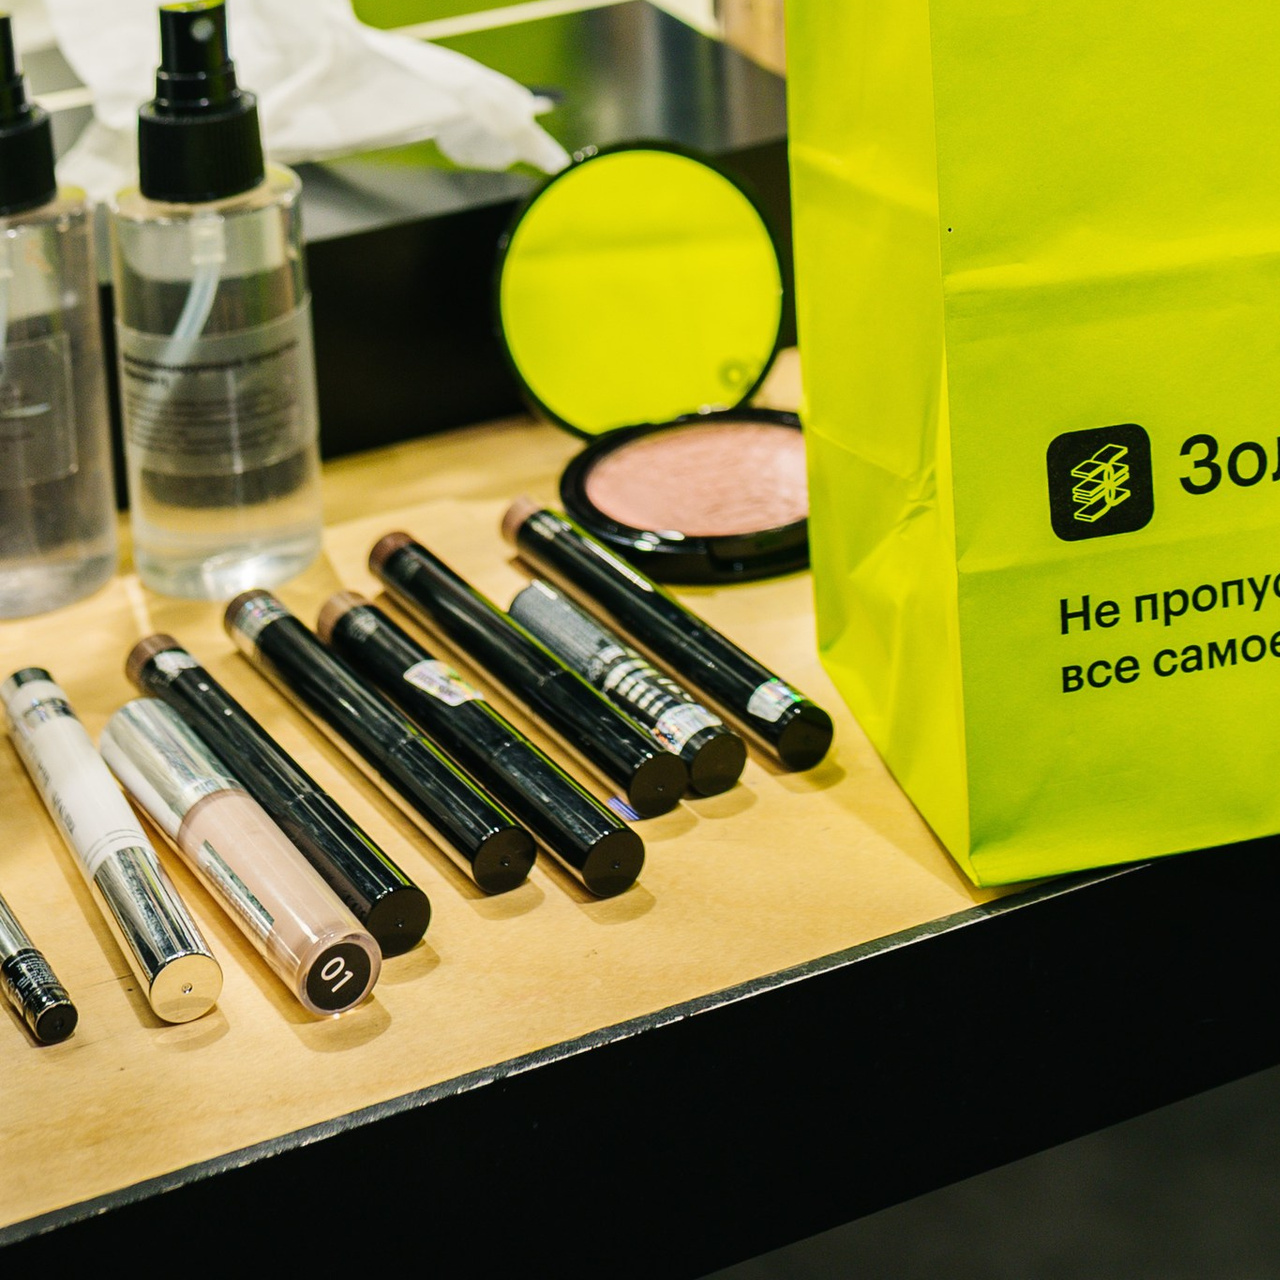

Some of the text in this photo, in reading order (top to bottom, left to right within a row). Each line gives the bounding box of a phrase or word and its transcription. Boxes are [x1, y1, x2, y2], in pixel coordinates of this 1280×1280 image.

[1059, 594, 1121, 635] Не
[1061, 655, 1140, 694] все
[320, 956, 354, 993] 01
